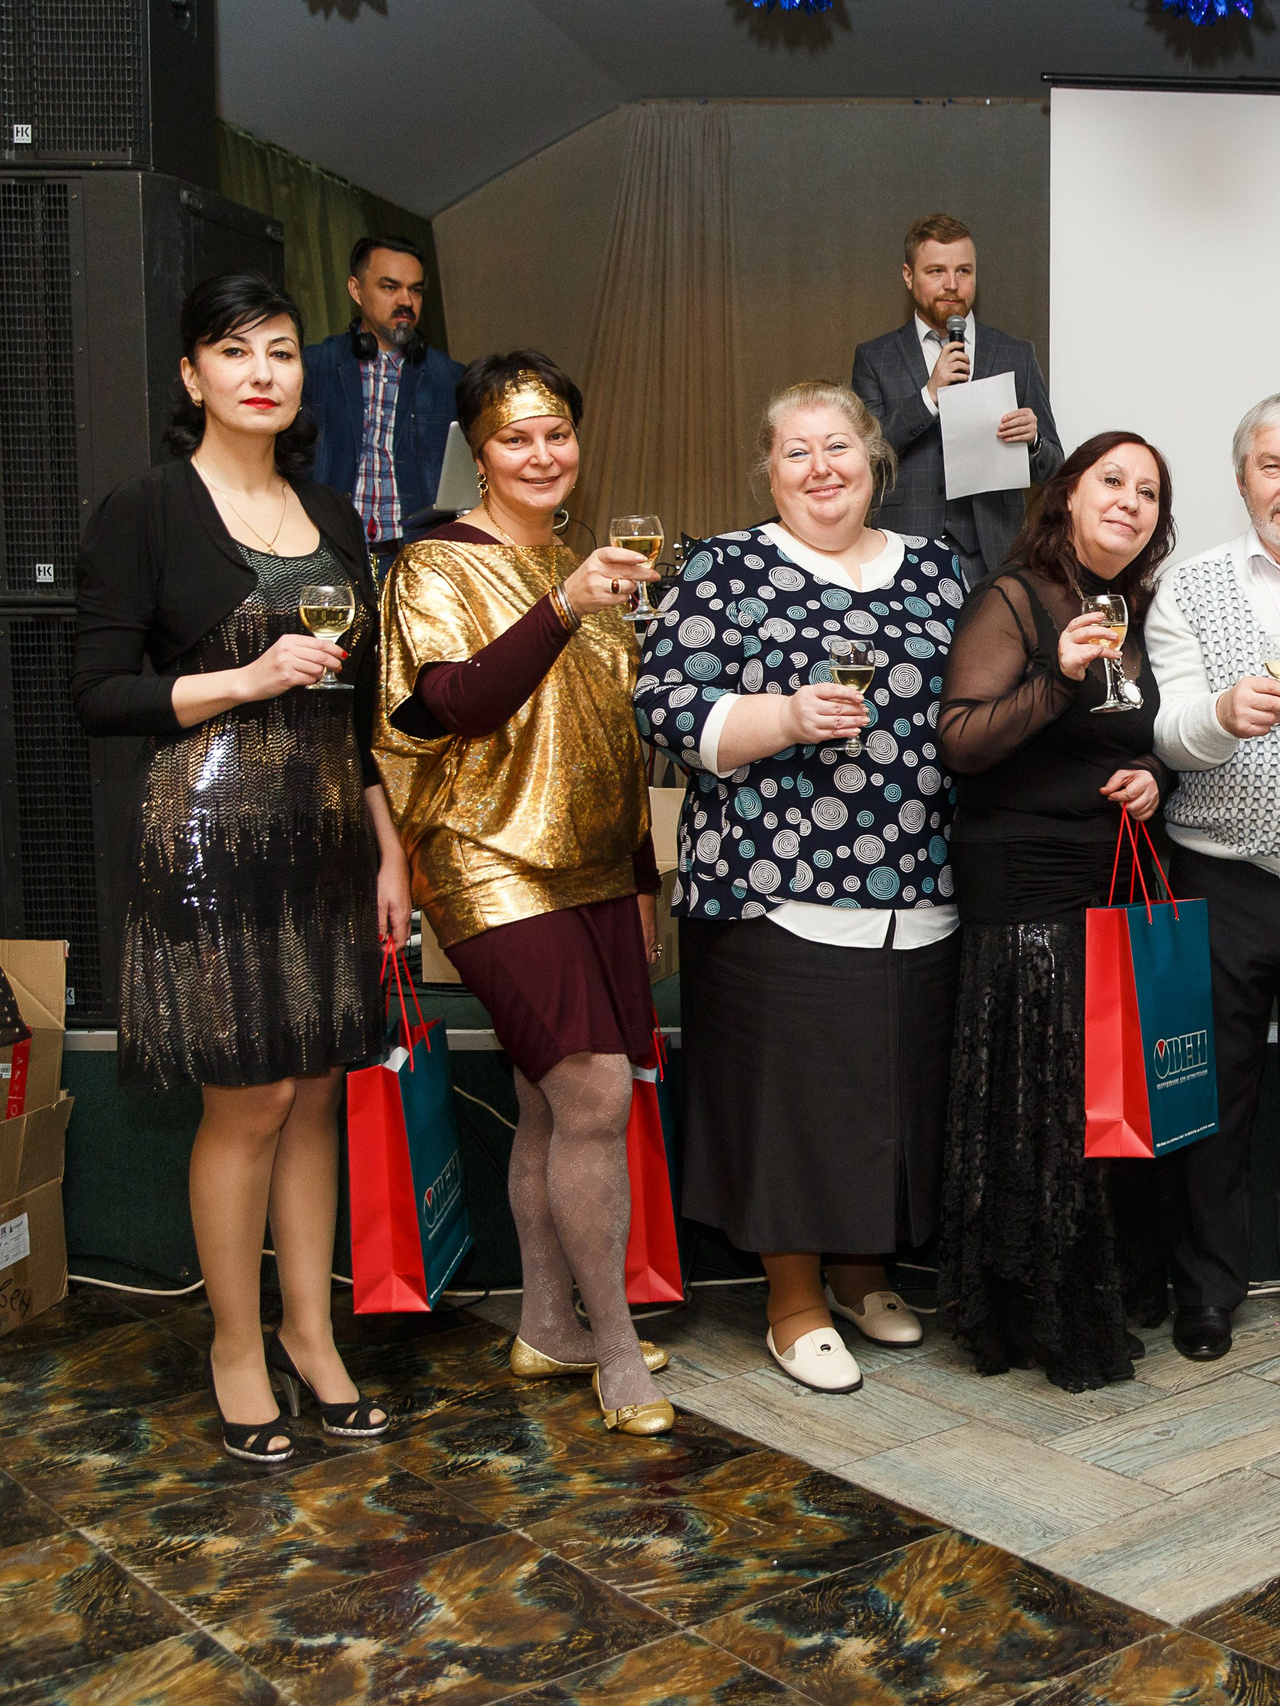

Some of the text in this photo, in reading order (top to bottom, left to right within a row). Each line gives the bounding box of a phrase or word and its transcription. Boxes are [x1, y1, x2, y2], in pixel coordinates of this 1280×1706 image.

[16, 126, 30, 137] HK
[38, 566, 52, 577] HK
[1153, 1029, 1208, 1080] ОВЕН
